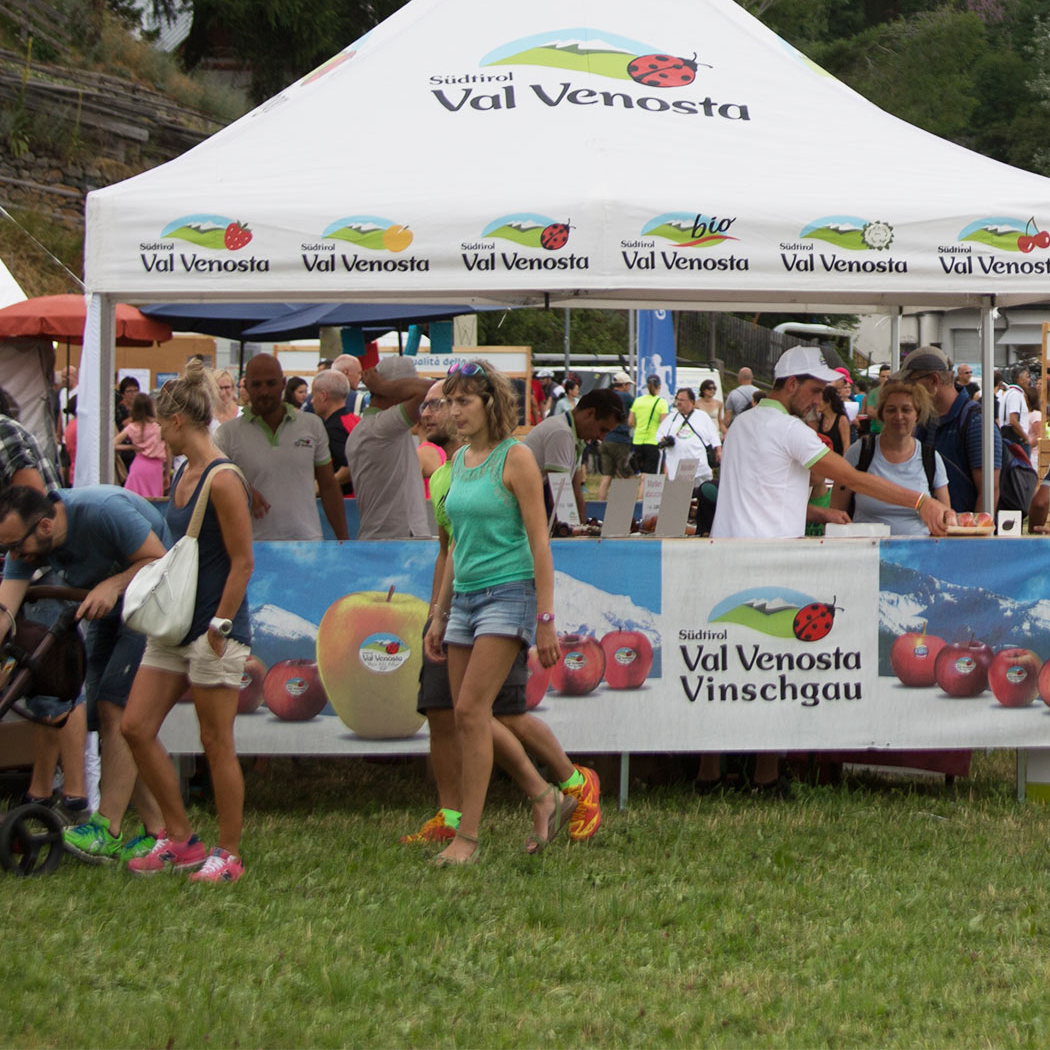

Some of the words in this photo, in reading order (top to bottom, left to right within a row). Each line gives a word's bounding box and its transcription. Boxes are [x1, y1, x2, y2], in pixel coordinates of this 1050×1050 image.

[430, 71, 514, 86] Südtirol
[431, 85, 517, 113] Val
[530, 82, 751, 121] Venosta
[691, 213, 737, 239] bio
[301, 243, 335, 251] Südtirol
[461, 242, 495, 250] Südtirol
[620, 240, 655, 248] Südtirol
[779, 242, 814, 251] Südtirol
[937, 245, 972, 254] Südtirol
[140, 253, 175, 273] Val
[181, 253, 270, 273] Venosta
[302, 254, 336, 272] Val
[341, 254, 430, 272] Venosta
[462, 252, 496, 271] Val
[501, 252, 589, 270] Venosta
[621, 251, 656, 270] Val
[661, 251, 749, 271] Venosta
[780, 253, 815, 272] Val
[820, 253, 908, 273] Venosta
[938, 256, 972, 275] Val
[413, 356, 440, 366] ualità
[679, 629, 728, 641] Südtirol
[679, 644, 728, 672] Val
[736, 644, 862, 672] Venosta
[680, 674, 862, 707] Vinschgau
